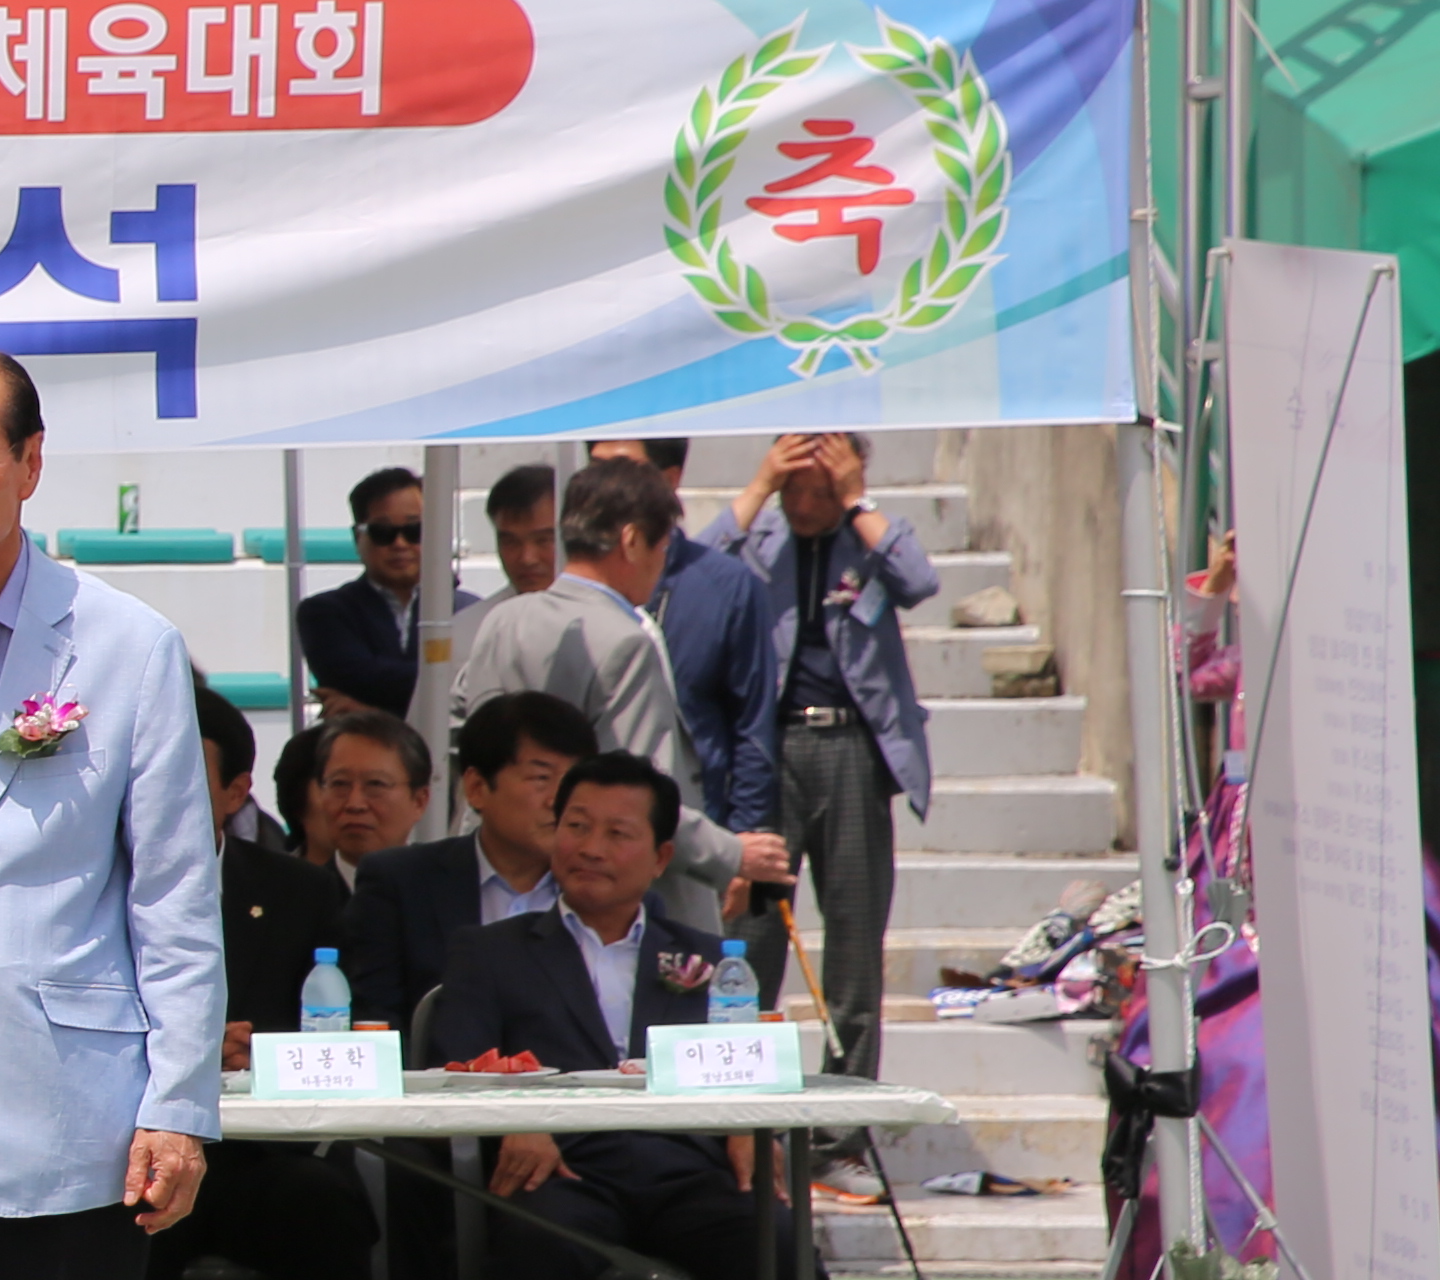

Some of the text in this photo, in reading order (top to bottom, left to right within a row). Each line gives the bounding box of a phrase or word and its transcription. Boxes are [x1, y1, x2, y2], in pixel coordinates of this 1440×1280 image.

[748, 121, 913, 273] 축
[287, 1046, 365, 1070] 김 봉 학
[686, 1040, 763, 1066] 이 갑 재
